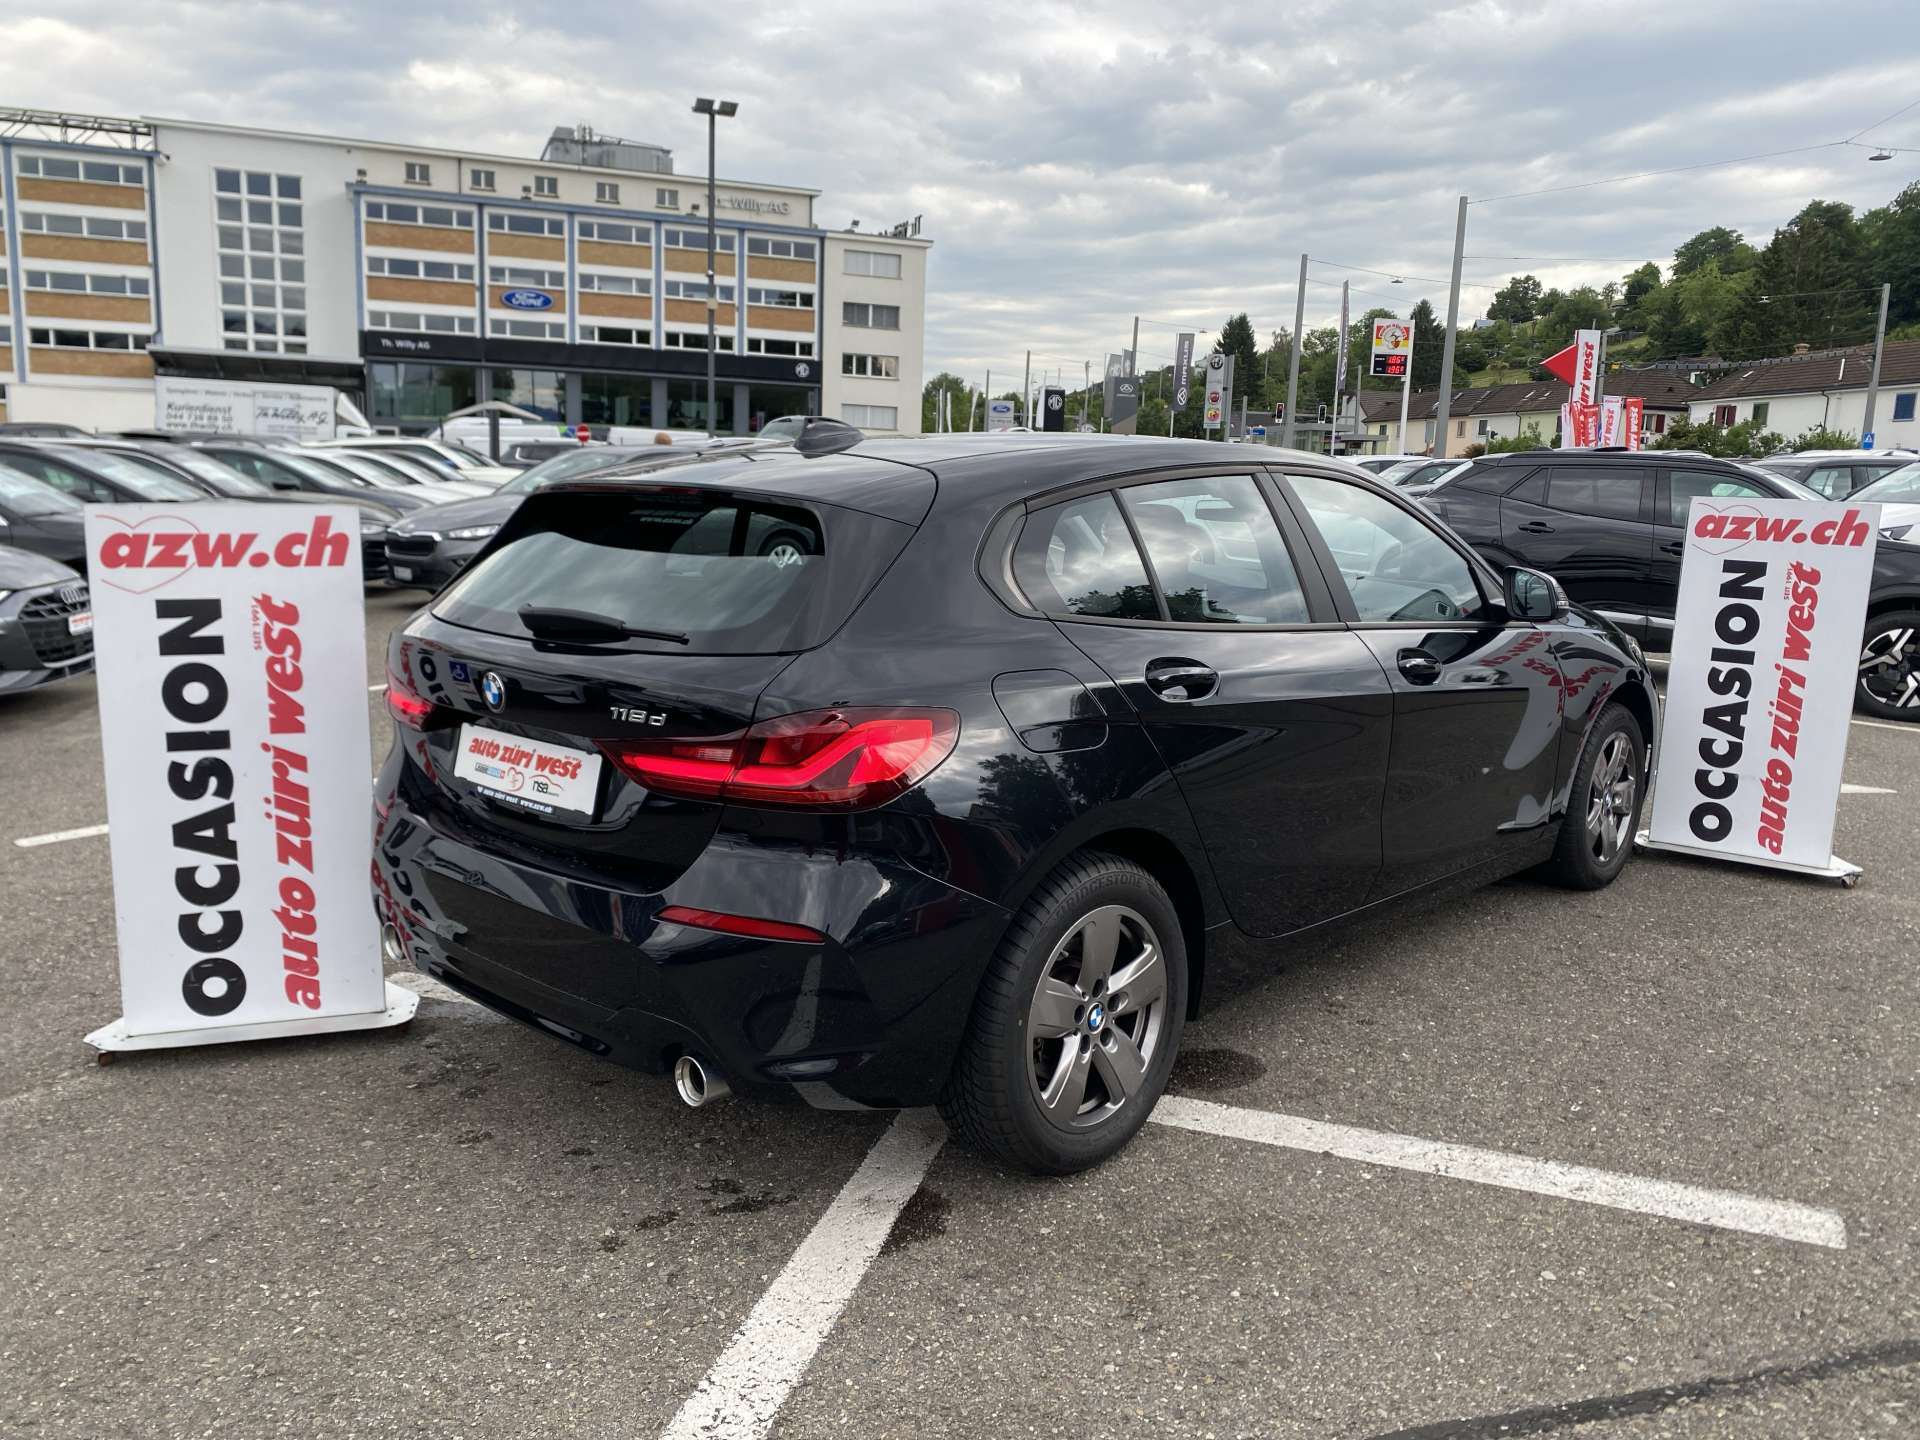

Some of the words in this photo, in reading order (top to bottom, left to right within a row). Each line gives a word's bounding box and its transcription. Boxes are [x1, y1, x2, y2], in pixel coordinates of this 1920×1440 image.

[730, 196, 762, 215] Willy
[766, 200, 791, 215] AG
[416, 340, 431, 350] AG
[1048, 394, 1063, 411] MG
[100, 515, 350, 569] azw.ch
[1693, 509, 1870, 547] azw.ch
[1782, 560, 1823, 662] west
[251, 592, 307, 735] west
[1688, 559, 1768, 843] OCCASION
[1767, 662, 1808, 761] züri
[155, 598, 247, 1017] OCCASION
[468, 737, 500, 760] auto
[498, 743, 537, 769] züri
[534, 752, 583, 780] west
[532, 780, 549, 793] nsa
[1757, 757, 1794, 856] auto
[260, 742, 315, 875] züri
[272, 876, 322, 1011] auto
